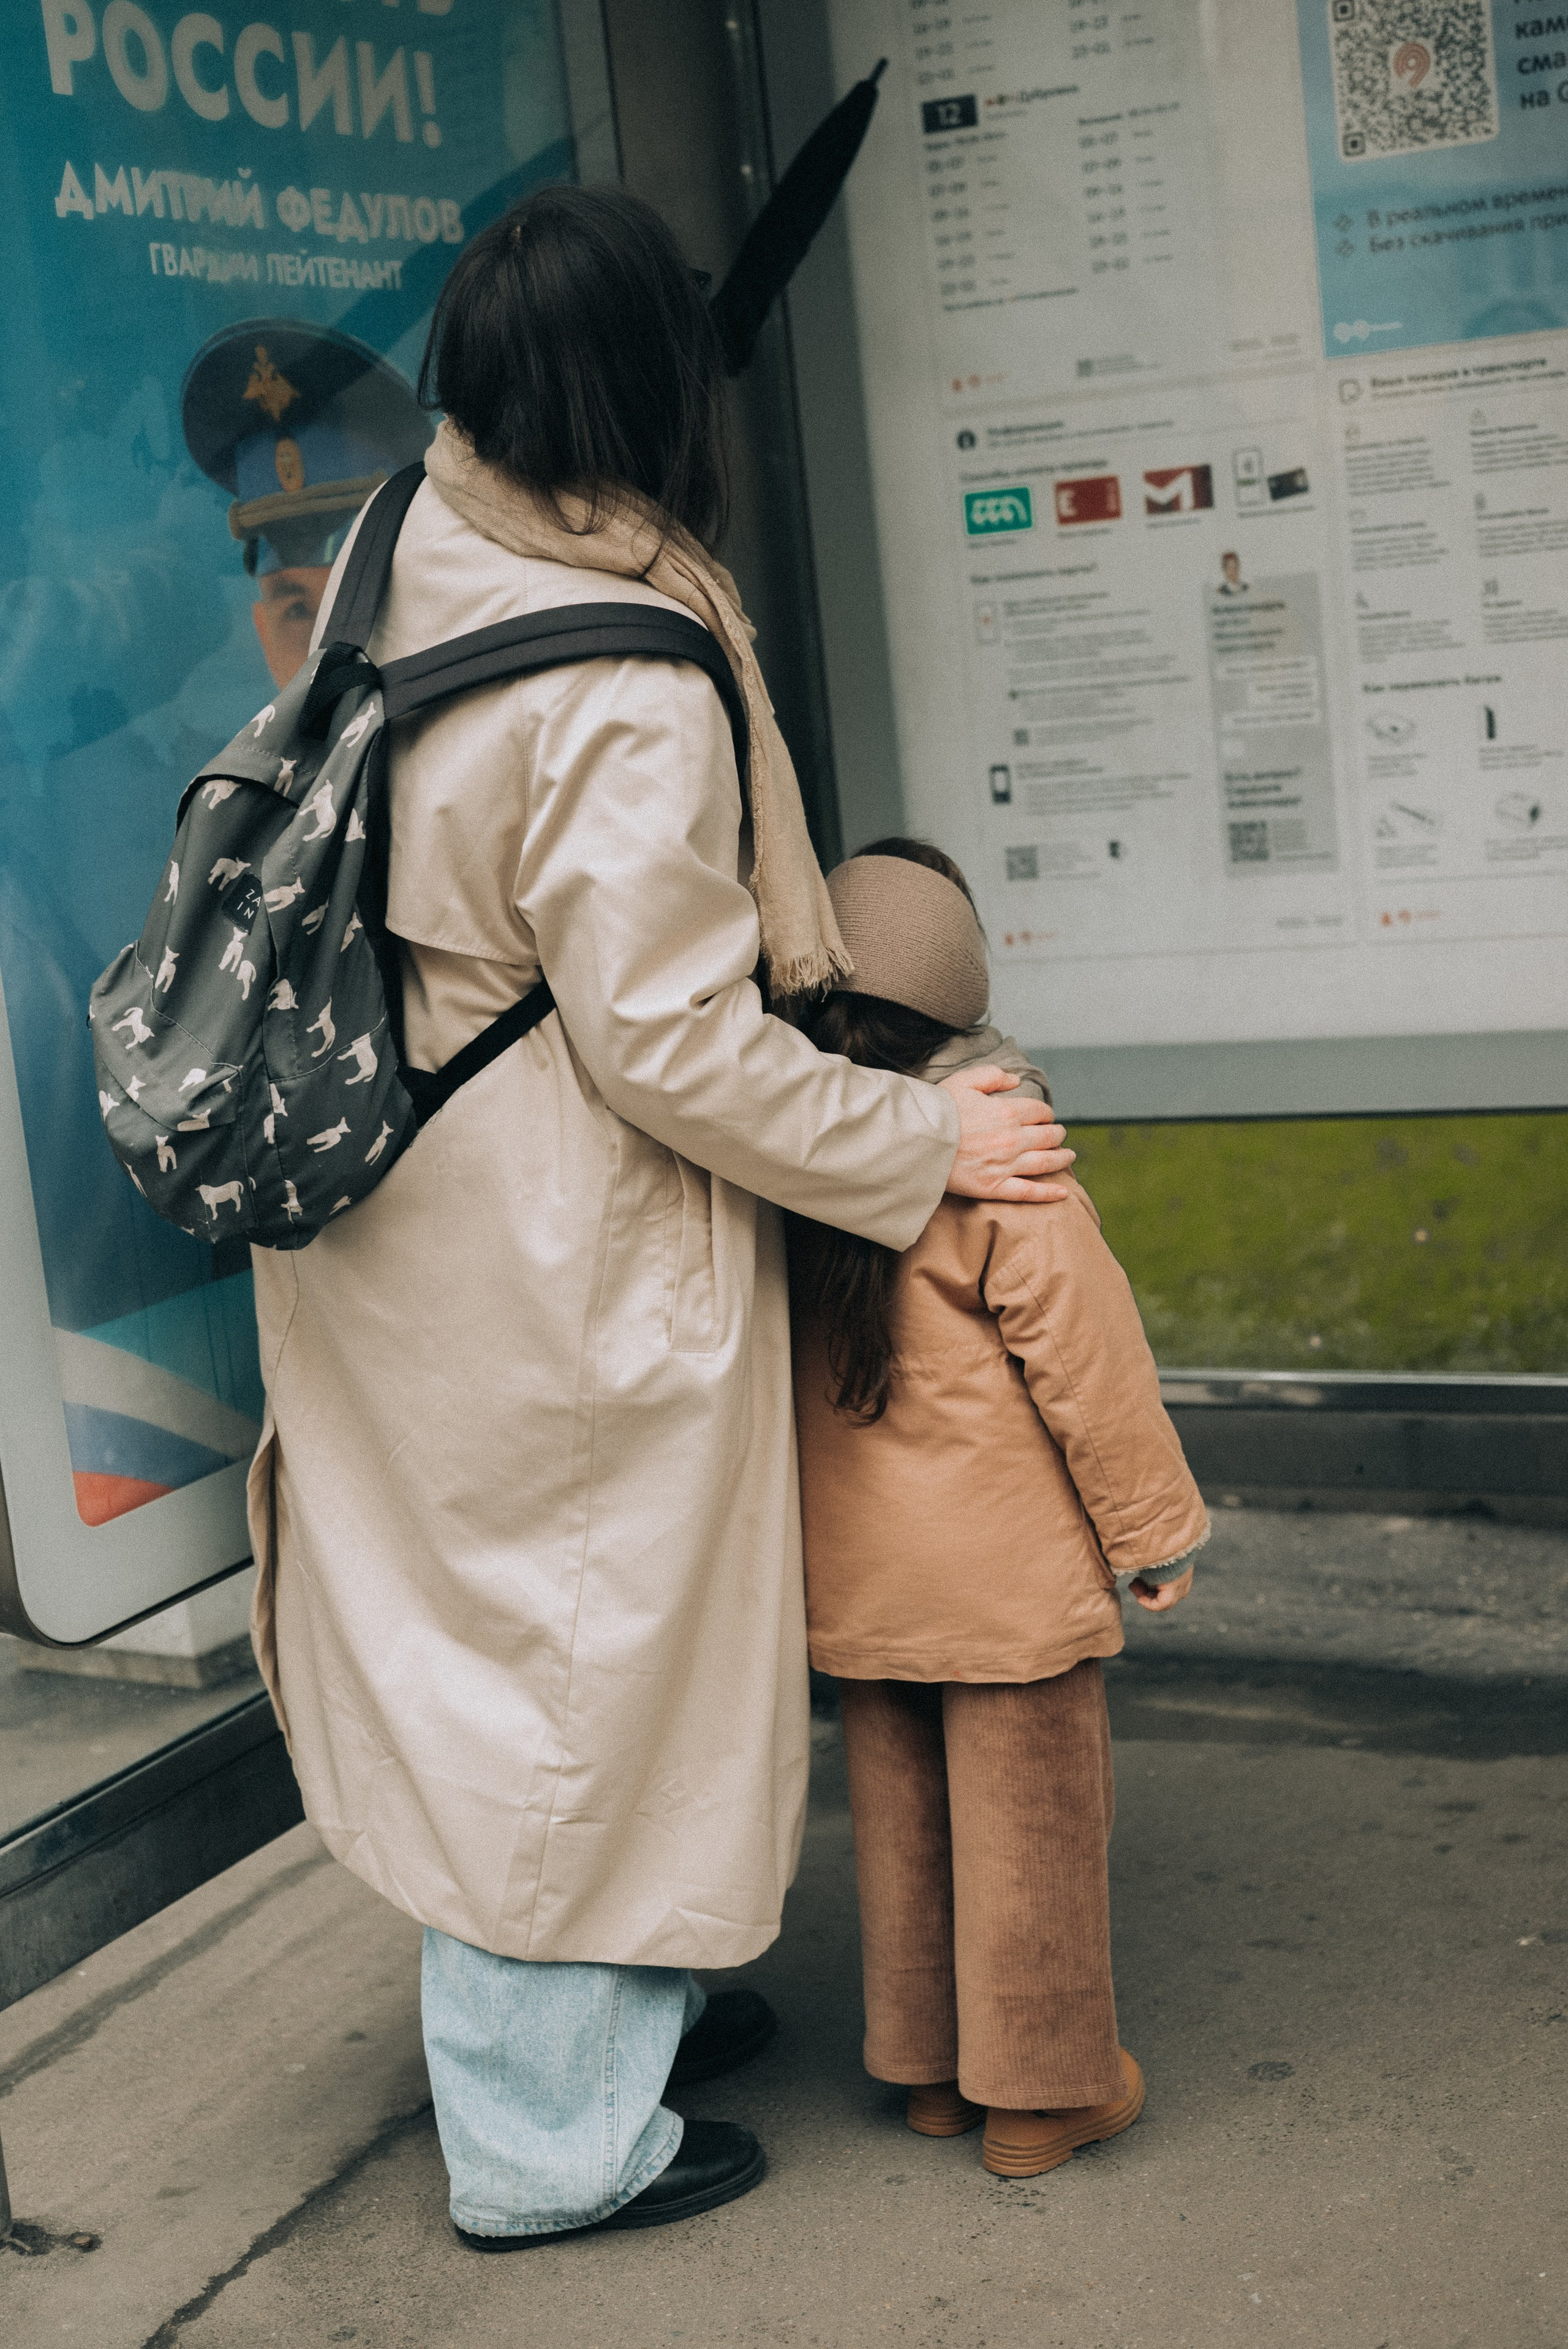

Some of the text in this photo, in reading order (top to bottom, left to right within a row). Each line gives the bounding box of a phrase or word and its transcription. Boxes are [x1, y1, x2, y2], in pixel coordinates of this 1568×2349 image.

[1515, 15, 1568, 40] кам
[41, 0, 443, 149] РОССИИ!
[54, 160, 466, 245] ДМИТРИЙ ФЕДУЛОВ
[148, 242, 404, 290] ГВАРДИИ ЛЕЙТЕНАНТ
[236, 901, 255, 919] IN
[245, 889, 262, 907] ZA
